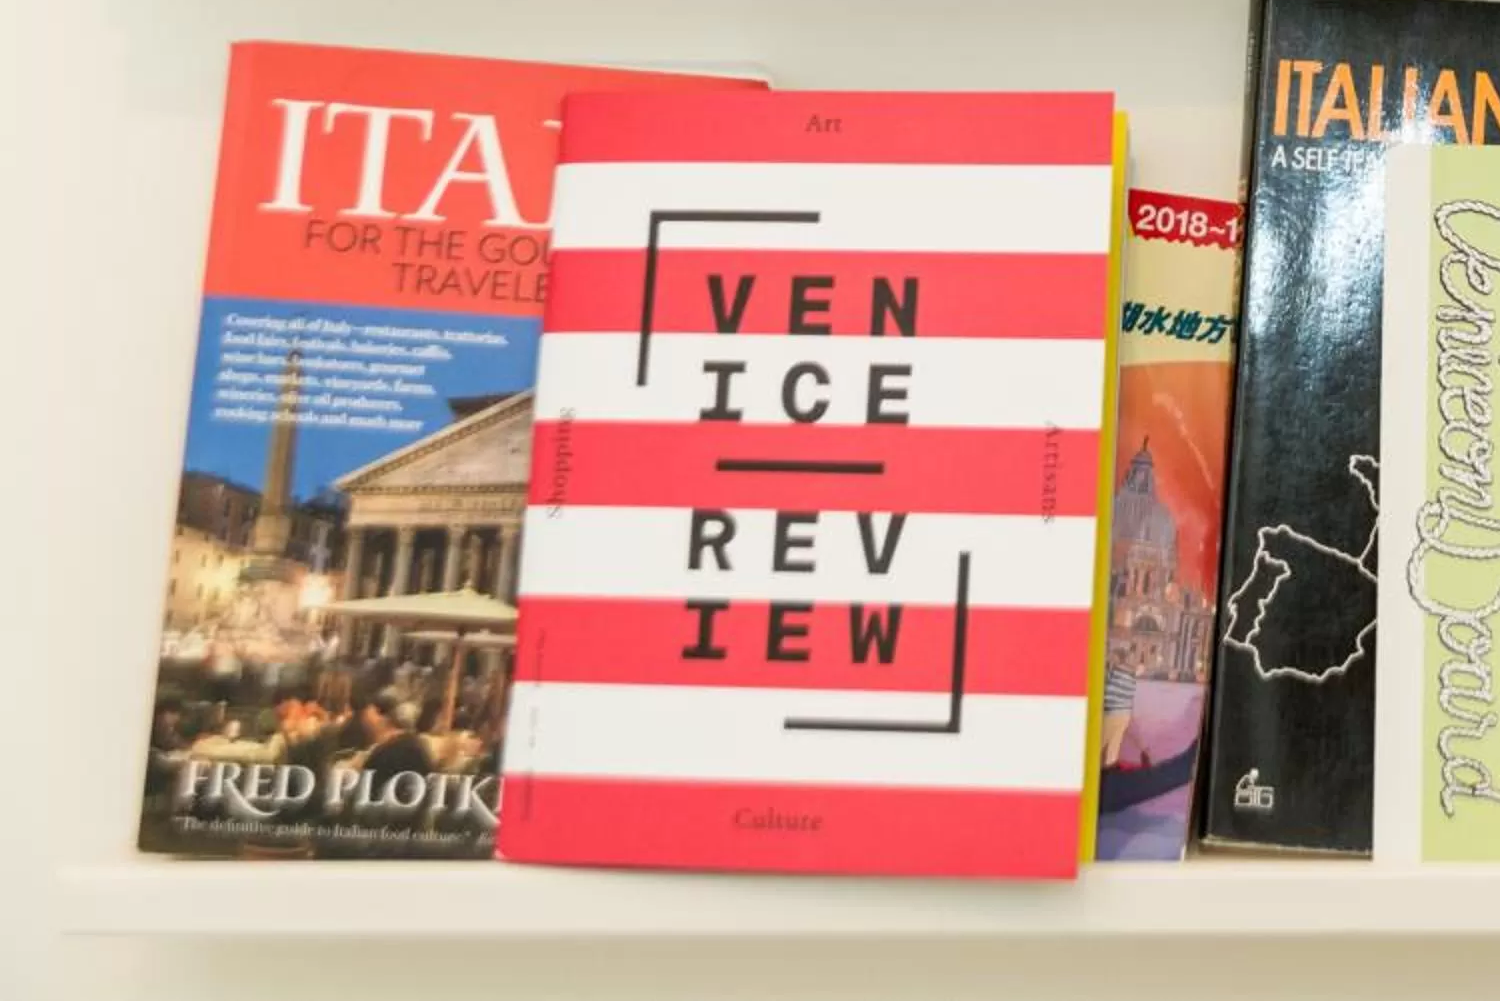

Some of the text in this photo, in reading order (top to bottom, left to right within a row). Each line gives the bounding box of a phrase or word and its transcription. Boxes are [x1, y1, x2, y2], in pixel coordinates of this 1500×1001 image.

[804, 114, 842, 136] Art
[1271, 144, 1288, 168] A
[258, 97, 562, 230] ITA
[304, 219, 383, 256] FOR
[392, 225, 468, 261] THE
[706, 274, 920, 338] VEN
[699, 360, 912, 425] ICE
[547, 406, 577, 520] Shopping
[1041, 419, 1063, 527] Artisans
[687, 509, 908, 575] REV
[681, 600, 903, 665] IEW
[180, 759, 316, 817] FRED
[732, 807, 823, 834] Culture
